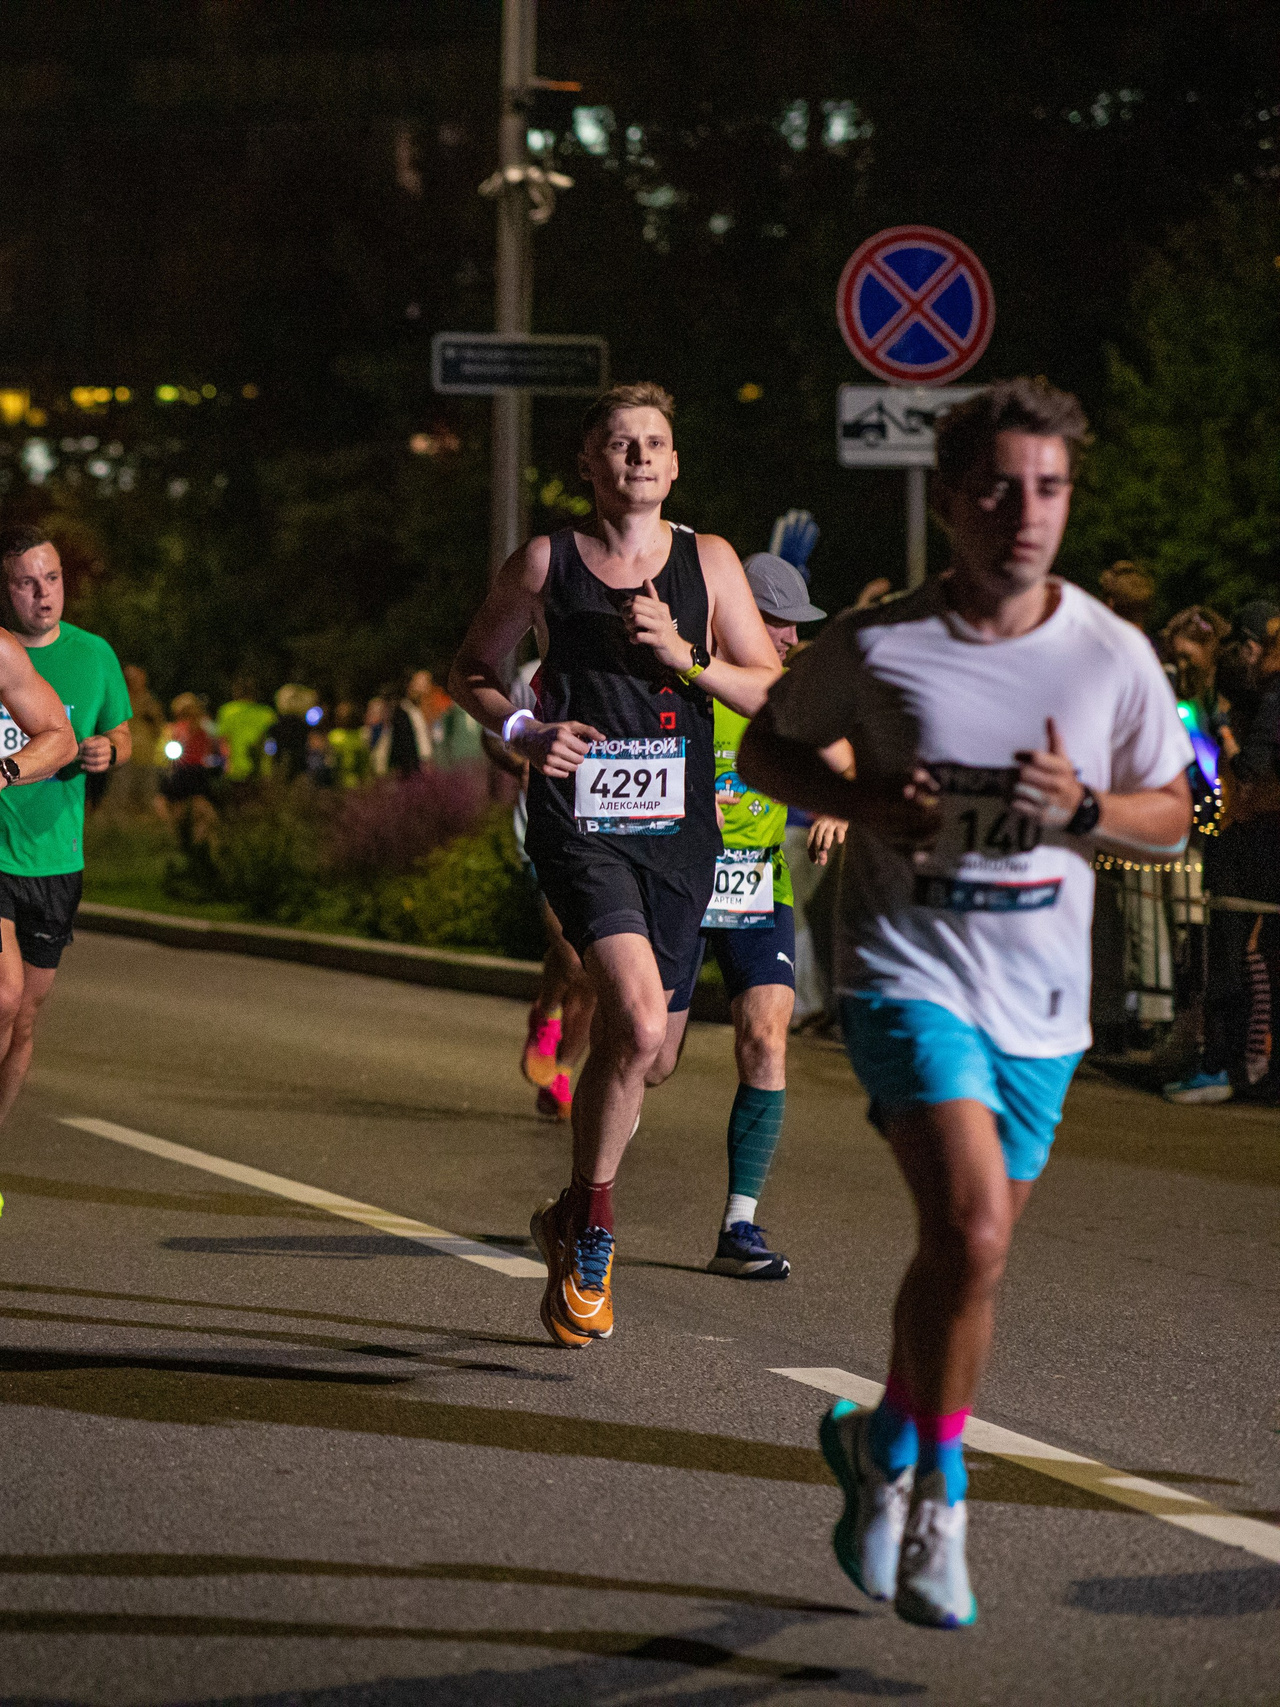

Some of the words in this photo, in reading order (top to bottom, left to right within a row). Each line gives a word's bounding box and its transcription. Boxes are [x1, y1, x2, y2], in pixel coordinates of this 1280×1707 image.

[589, 767, 668, 798] 4291
[599, 801, 661, 811] АЛЕКСАНДР
[714, 896, 742, 906] АРТЕМ
